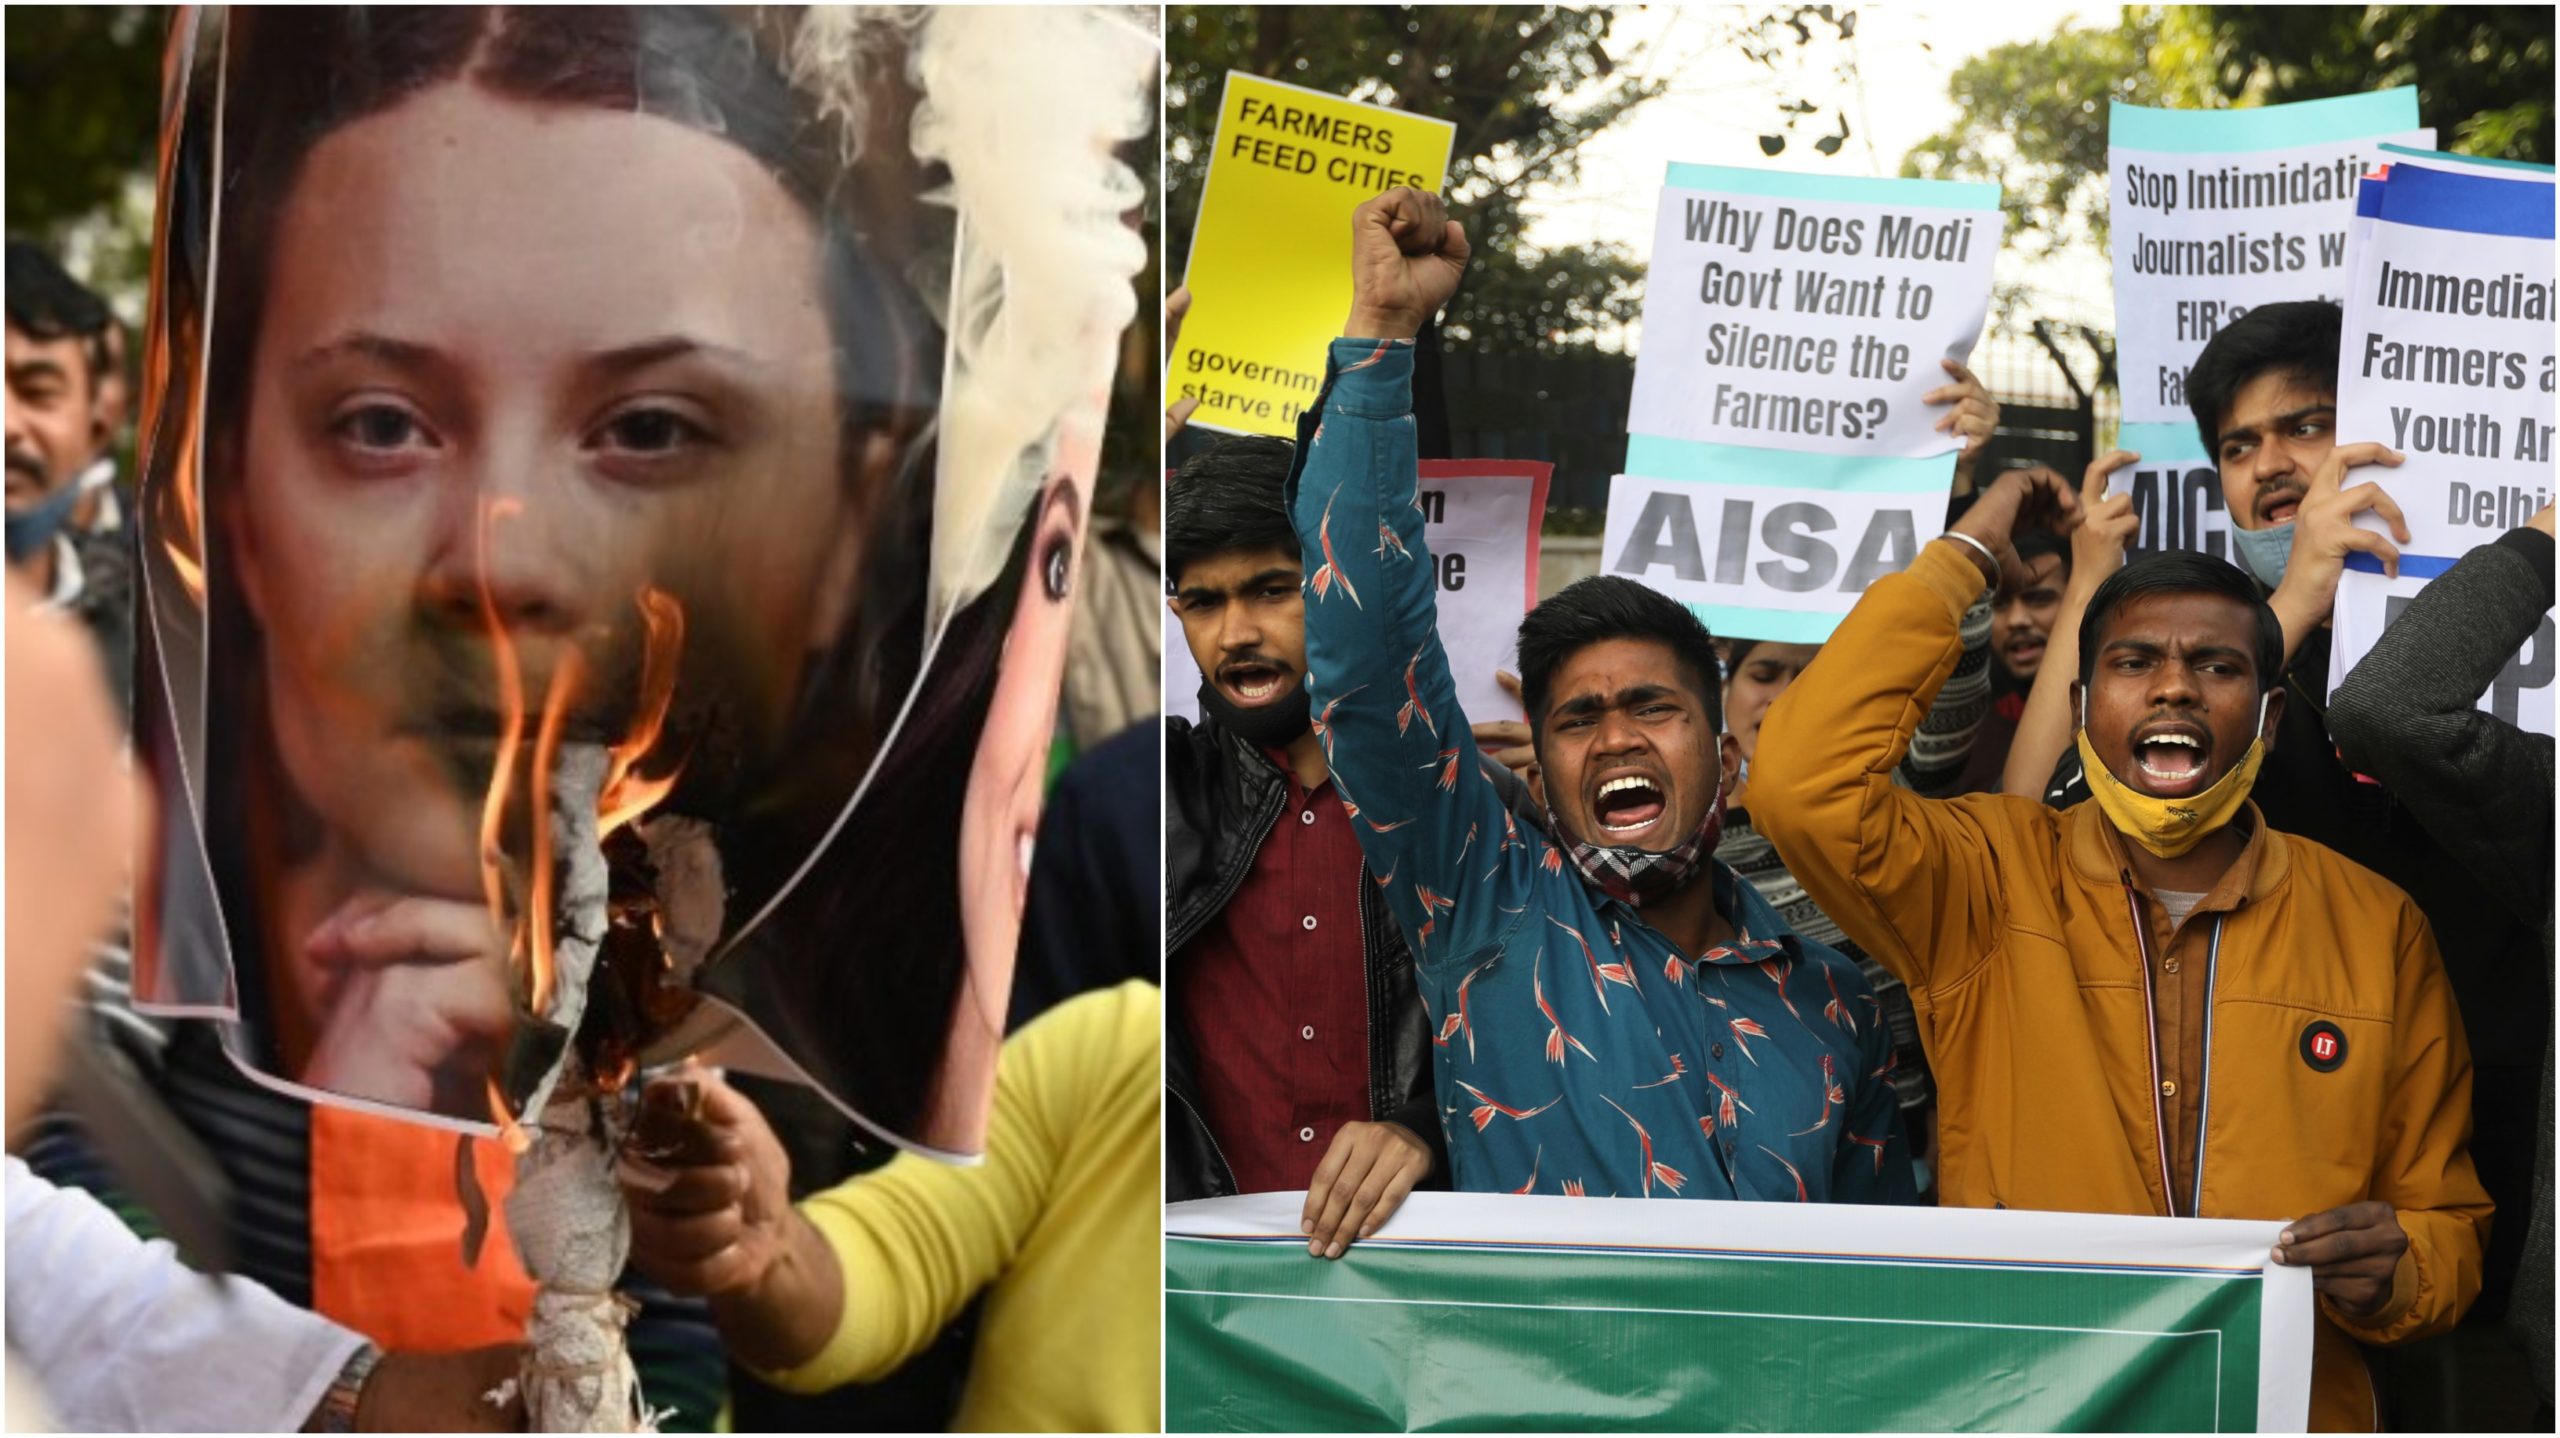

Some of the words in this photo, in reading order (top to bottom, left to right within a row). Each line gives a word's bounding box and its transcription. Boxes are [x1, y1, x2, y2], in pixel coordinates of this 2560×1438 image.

[1239, 97, 1394, 155] FARMERS
[1232, 134, 1317, 175] FEED
[1327, 157, 1424, 191] CITIES
[2127, 164, 2177, 216] Stop
[1685, 197, 1763, 253] Why
[1773, 206, 1864, 256] Does
[1876, 215, 1973, 262] Modi
[2133, 231, 2306, 276] Journalists
[1701, 261, 1782, 310] Govt
[1794, 269, 1885, 319] Want
[1896, 277, 1933, 321] to
[1706, 323, 1837, 375] Silence
[1850, 334, 1909, 381] the
[2362, 332, 2527, 390] Farmers
[1181, 381, 1271, 418] starve
[1712, 383, 1888, 440] Farmers?
[2390, 407, 2501, 459] Youth
[1613, 491, 1918, 593] AISA
